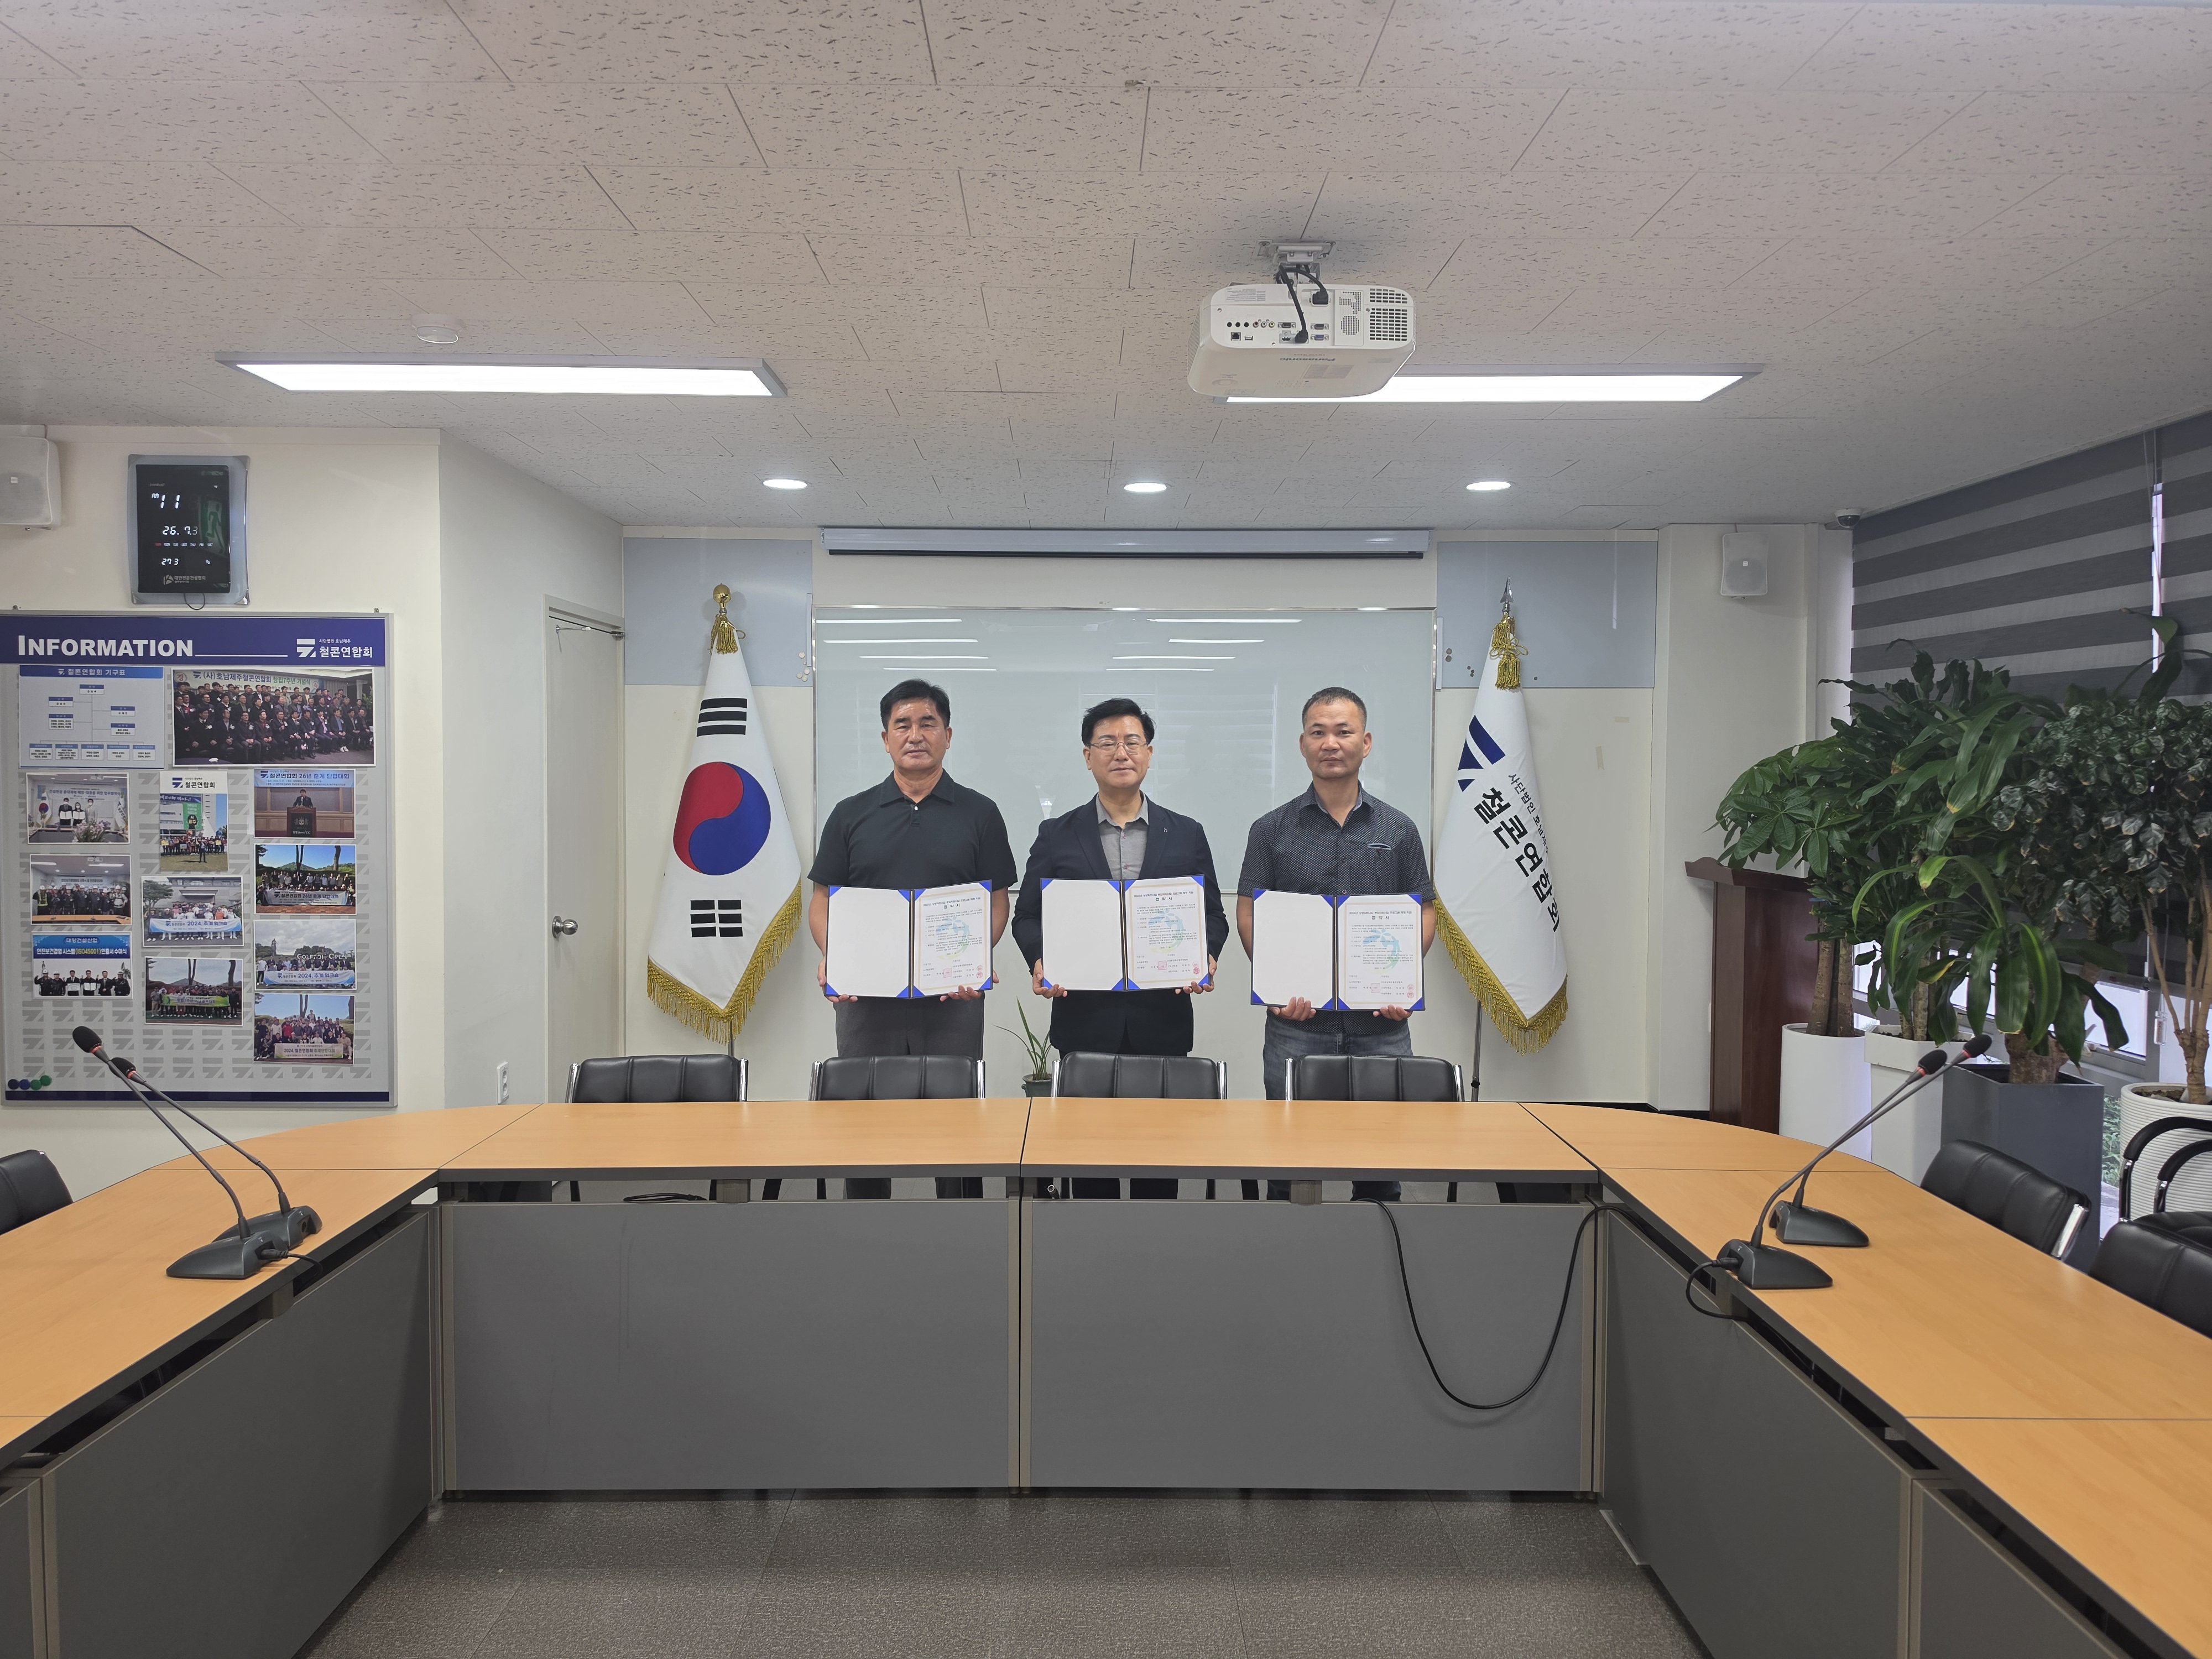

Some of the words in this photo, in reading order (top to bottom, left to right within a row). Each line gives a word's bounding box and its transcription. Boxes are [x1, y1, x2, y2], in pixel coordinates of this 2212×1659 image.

[18, 635, 193, 656] INFORMATION
[319, 646, 373, 658] 철콘연합회
[1508, 774, 1536, 815] 사단법인
